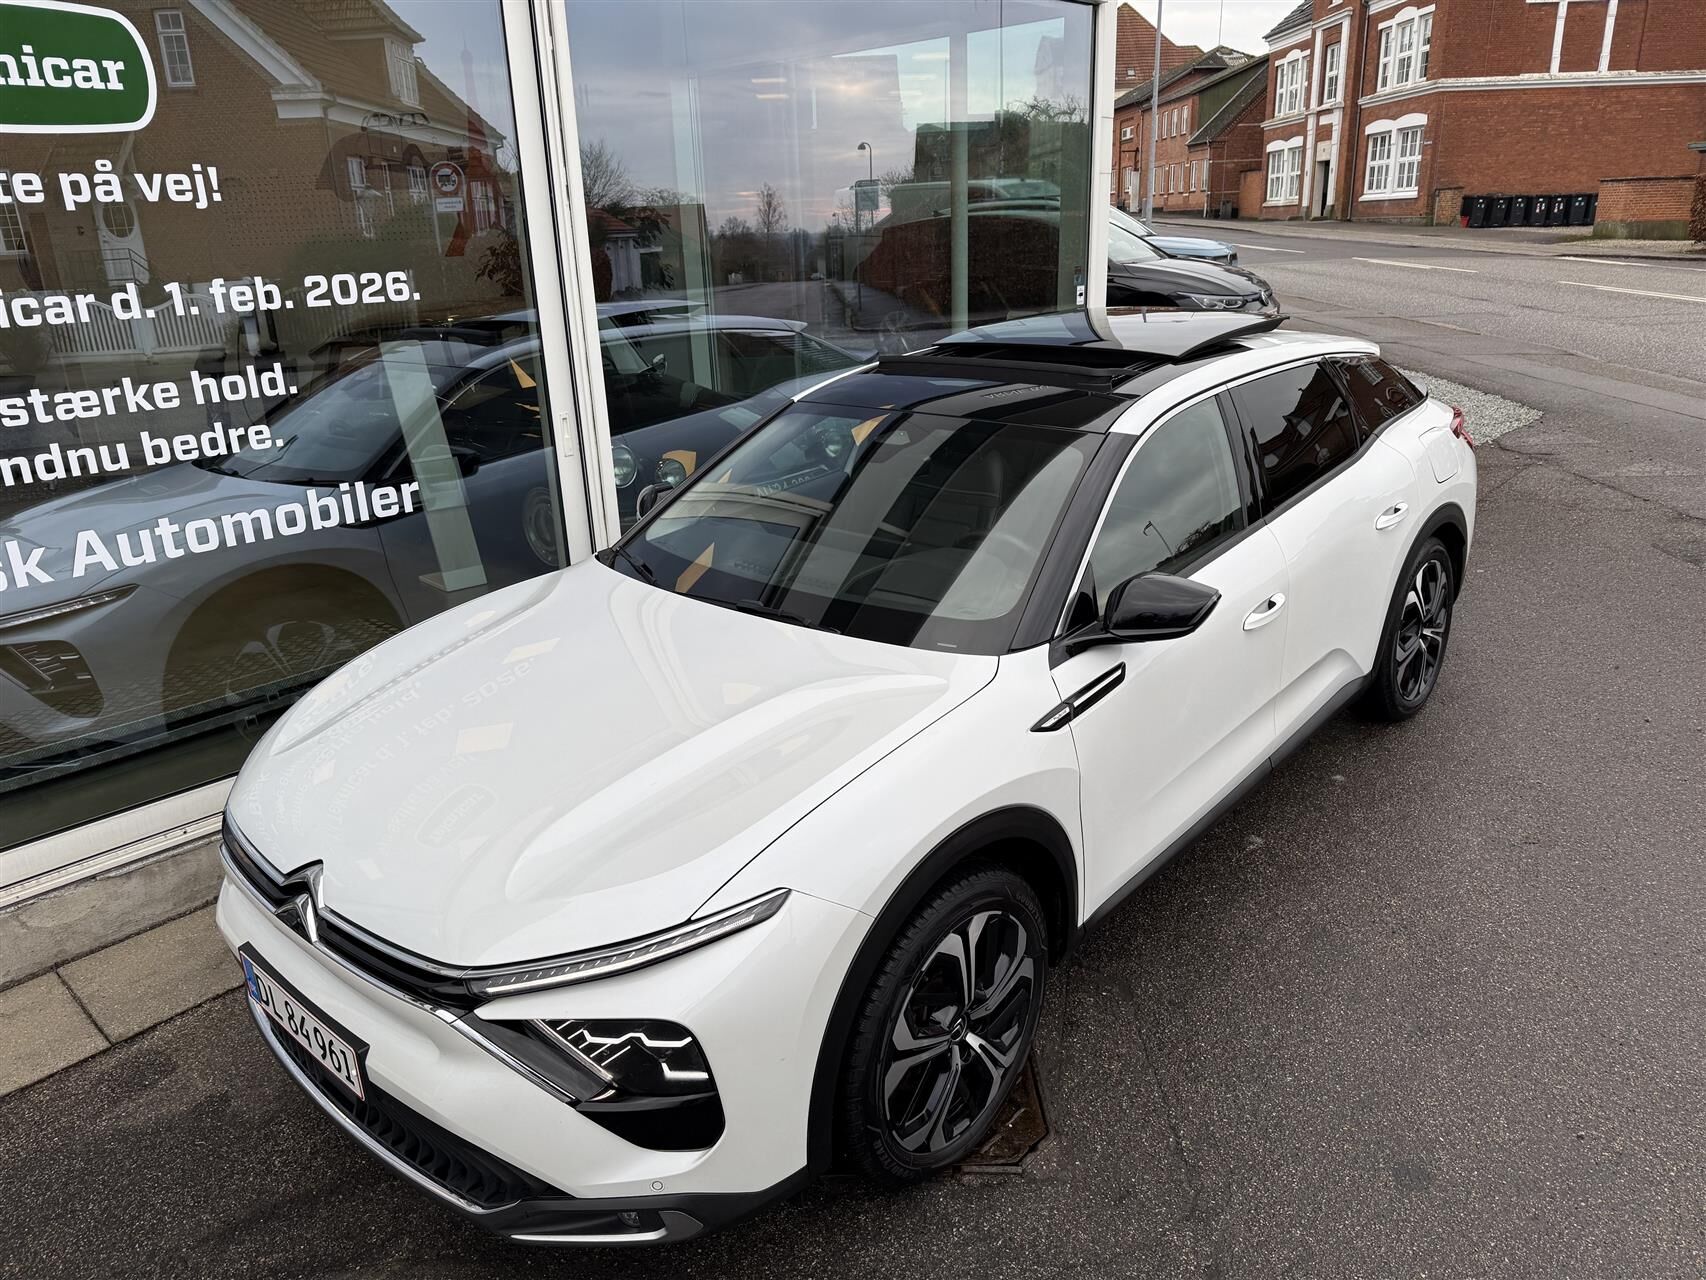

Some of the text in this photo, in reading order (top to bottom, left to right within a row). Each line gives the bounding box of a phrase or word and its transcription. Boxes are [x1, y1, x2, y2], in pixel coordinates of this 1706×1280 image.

[0, 44, 125, 90] nicar
[58, 159, 124, 211] på
[133, 163, 222, 209] vej!
[0, 271, 421, 329] icar d. 1. feb. 2026.
[0, 362, 298, 427] stærke hold.
[0, 421, 284, 487] ndnu bedre.
[72, 481, 420, 578] Automobiler
[254, 973, 356, 1087] DL 84 961
